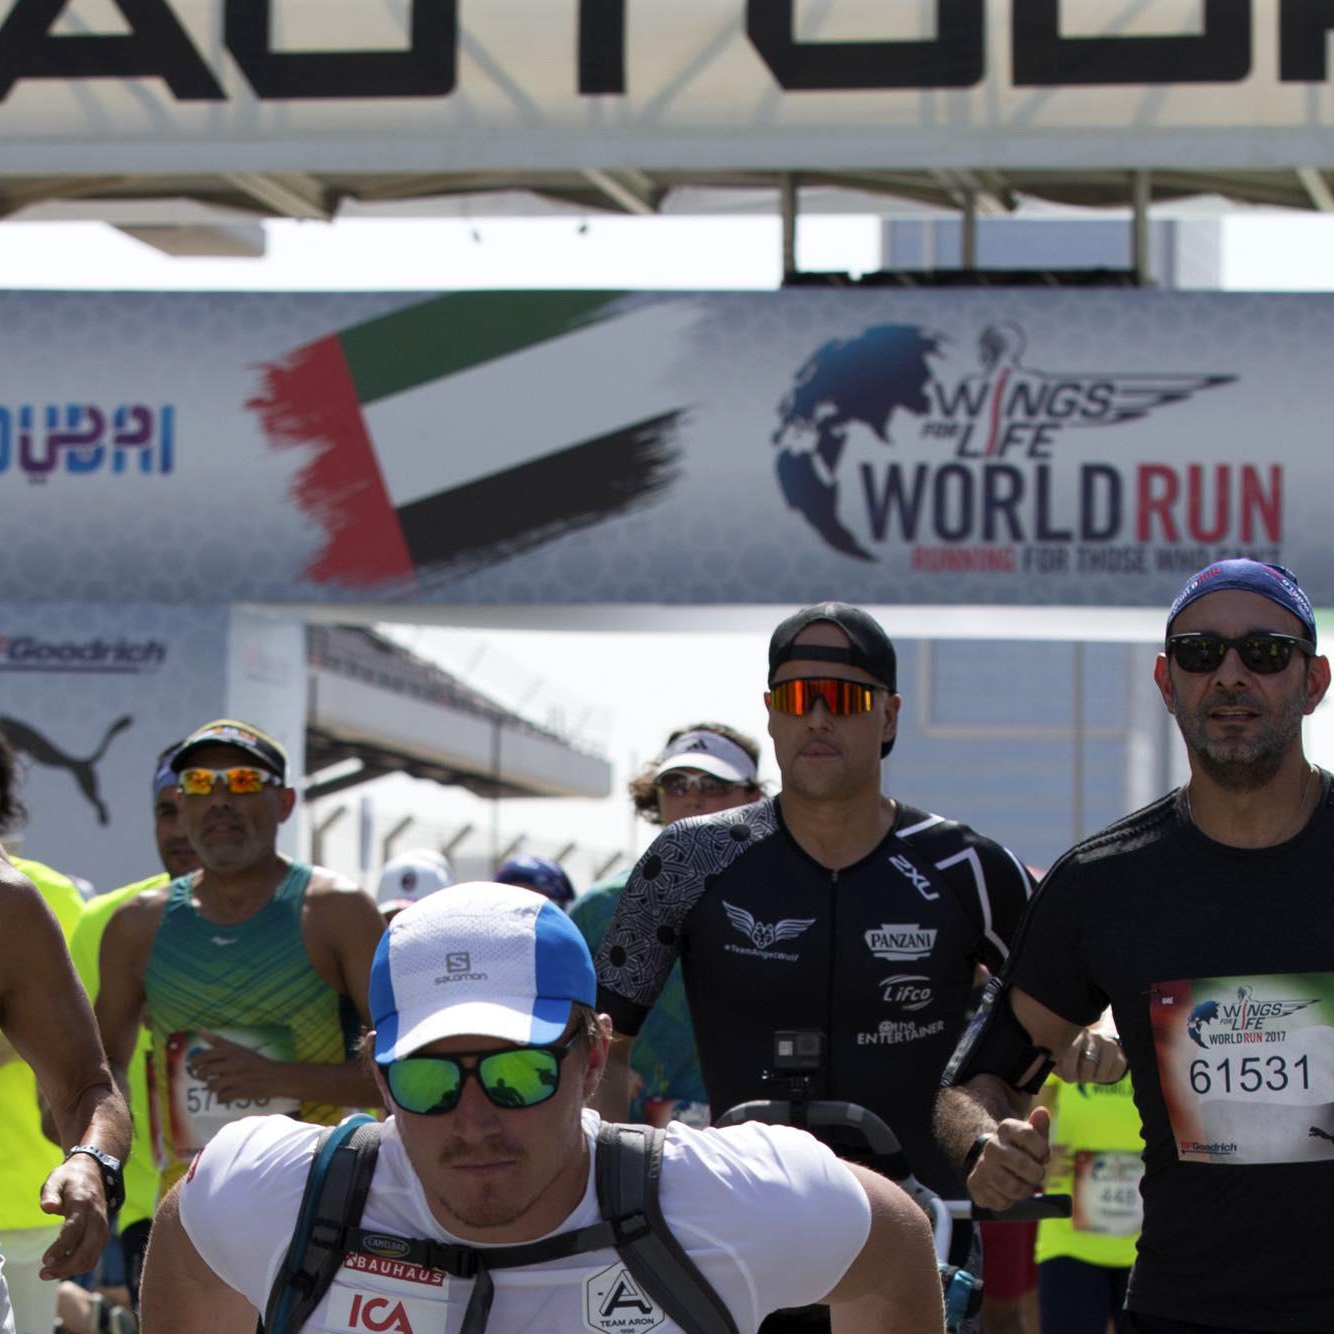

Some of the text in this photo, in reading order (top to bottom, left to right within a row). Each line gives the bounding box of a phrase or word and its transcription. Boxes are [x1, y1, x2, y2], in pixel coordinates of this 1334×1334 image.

[934, 380, 1117, 418] WINGS
[957, 422, 1063, 458] LIFE
[1135, 463, 1283, 543] RUN
[871, 933, 932, 949] PANZANI
[1223, 1002, 1282, 1016] WINGS
[857, 1021, 945, 1045] ENTERTAINER
[1231, 1018, 1266, 1030] LIFE
[1209, 1031, 1286, 1044] WORLD RUN 2017
[1190, 1054, 1310, 1094] 61531
[356, 1256, 444, 1284] BAUHAUS
[600, 1318, 655, 1328] TEAM ARON
